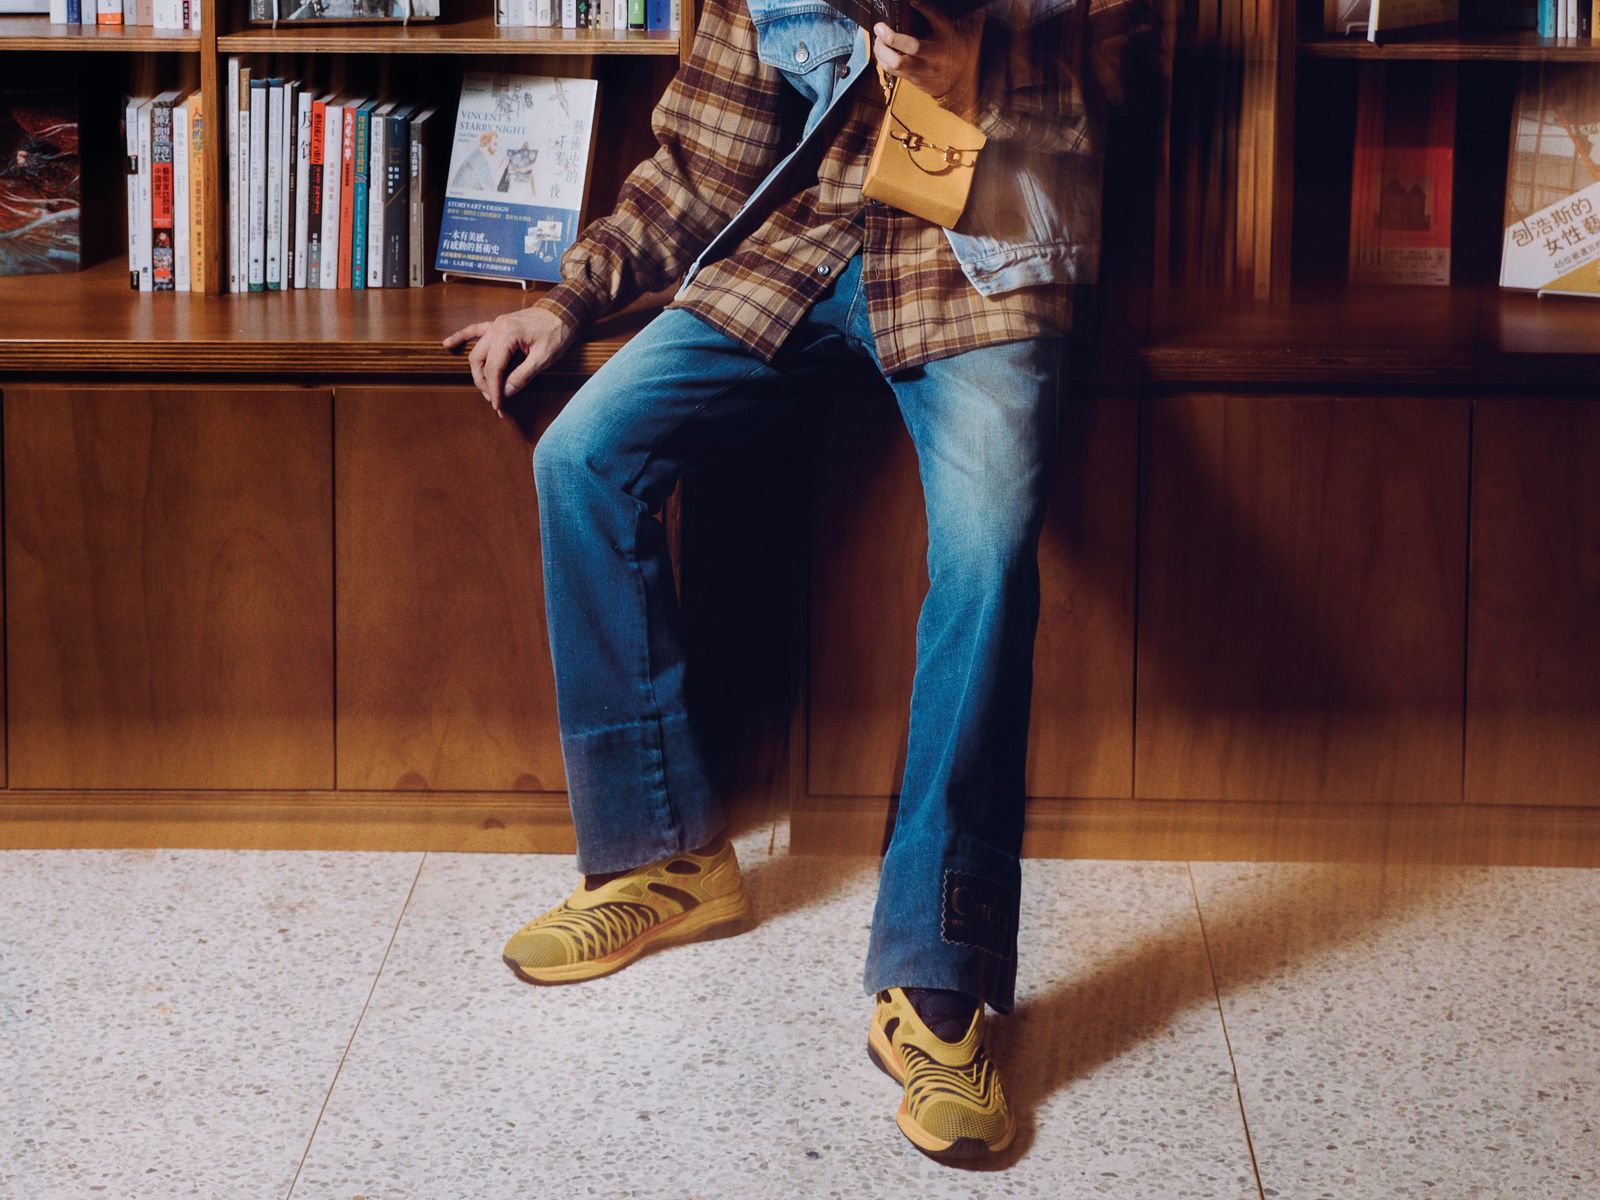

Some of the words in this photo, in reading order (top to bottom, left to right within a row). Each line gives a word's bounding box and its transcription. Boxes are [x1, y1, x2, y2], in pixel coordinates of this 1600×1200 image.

[496, 125, 528, 135] NIGHT
[1511, 198, 1592, 248] 包浩斯的
